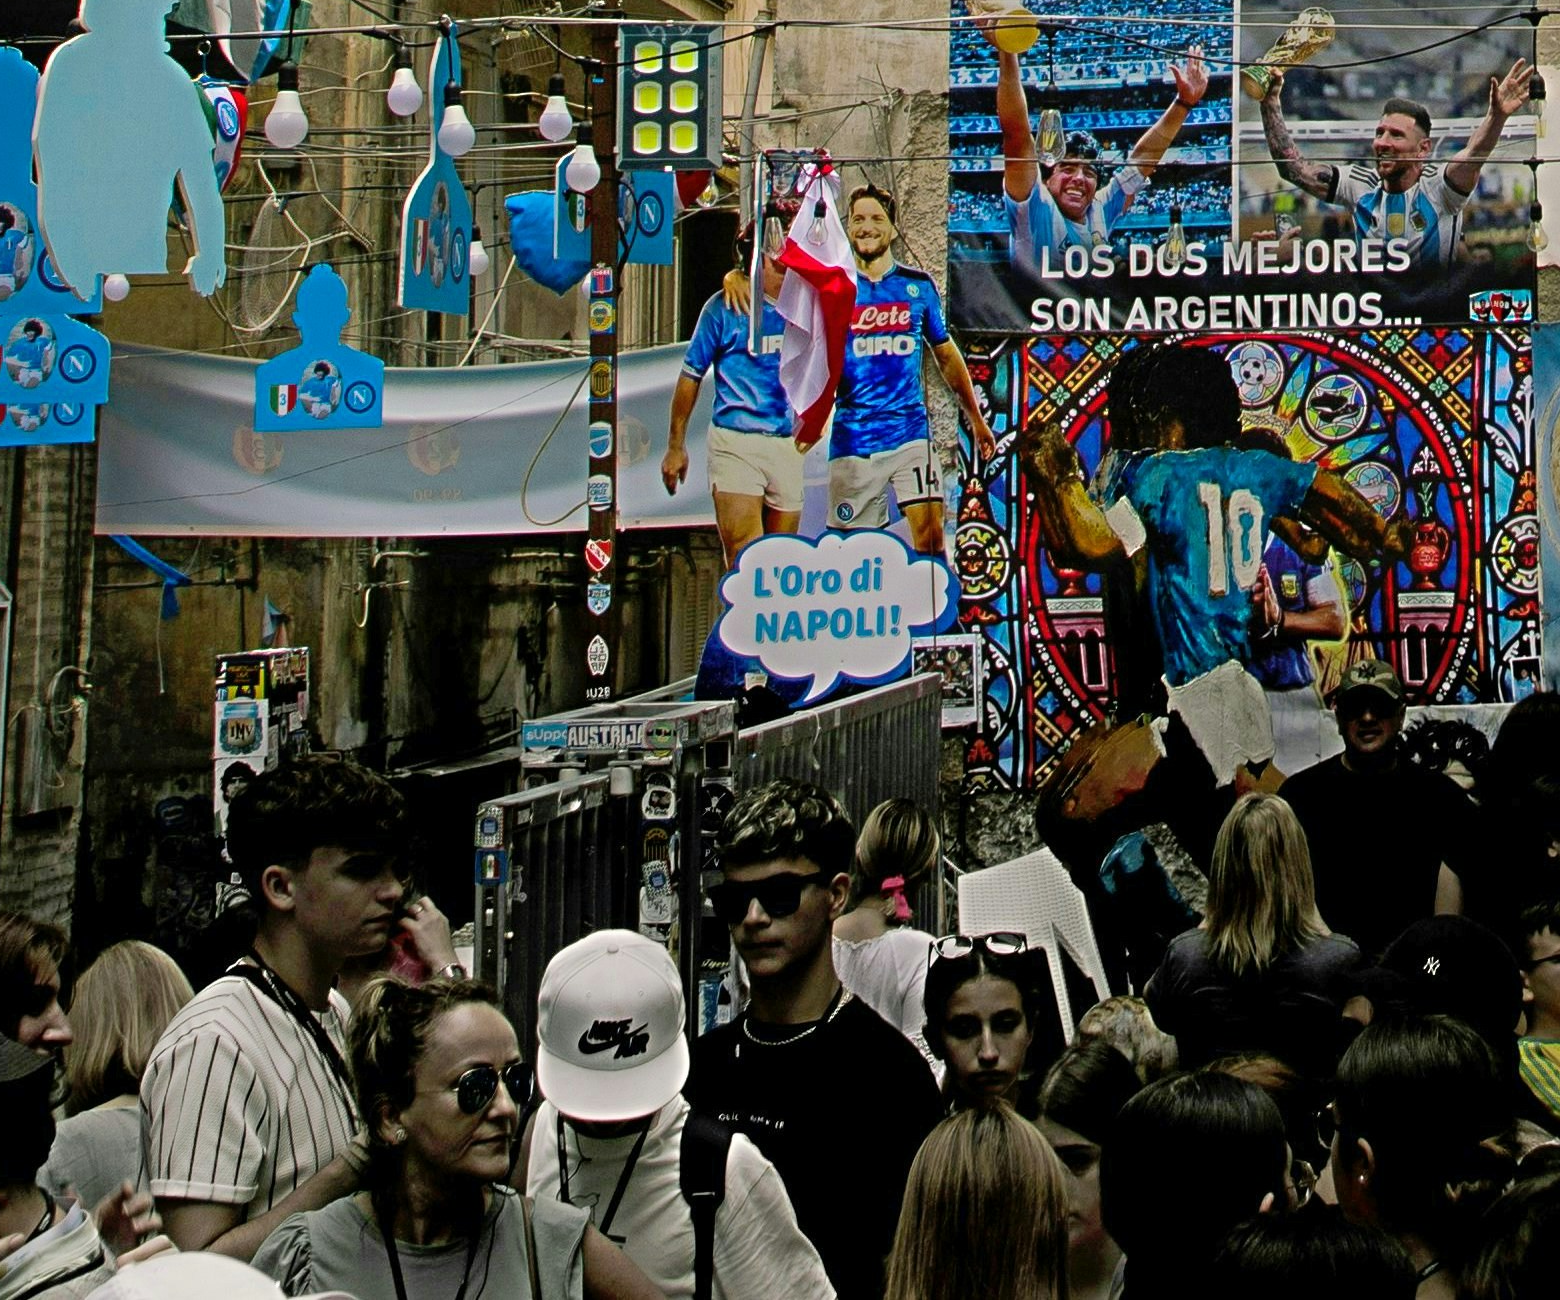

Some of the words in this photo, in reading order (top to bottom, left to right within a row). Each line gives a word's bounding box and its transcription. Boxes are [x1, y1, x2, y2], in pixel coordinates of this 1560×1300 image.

[1040, 242, 1114, 280] LOS
[1129, 240, 1207, 277] DOS
[1222, 237, 1411, 275] MEJORES
[850, 304, 912, 332] Lete
[1030, 296, 1115, 333] SON
[1124, 291, 1423, 330] ARGENTINOS....
[912, 464, 940, 495] 14
[1198, 482, 1265, 599] 10
[753, 565, 841, 599] L'Oro
[849, 557, 883, 592] di
[754, 604, 902, 643] NAPOLI!
